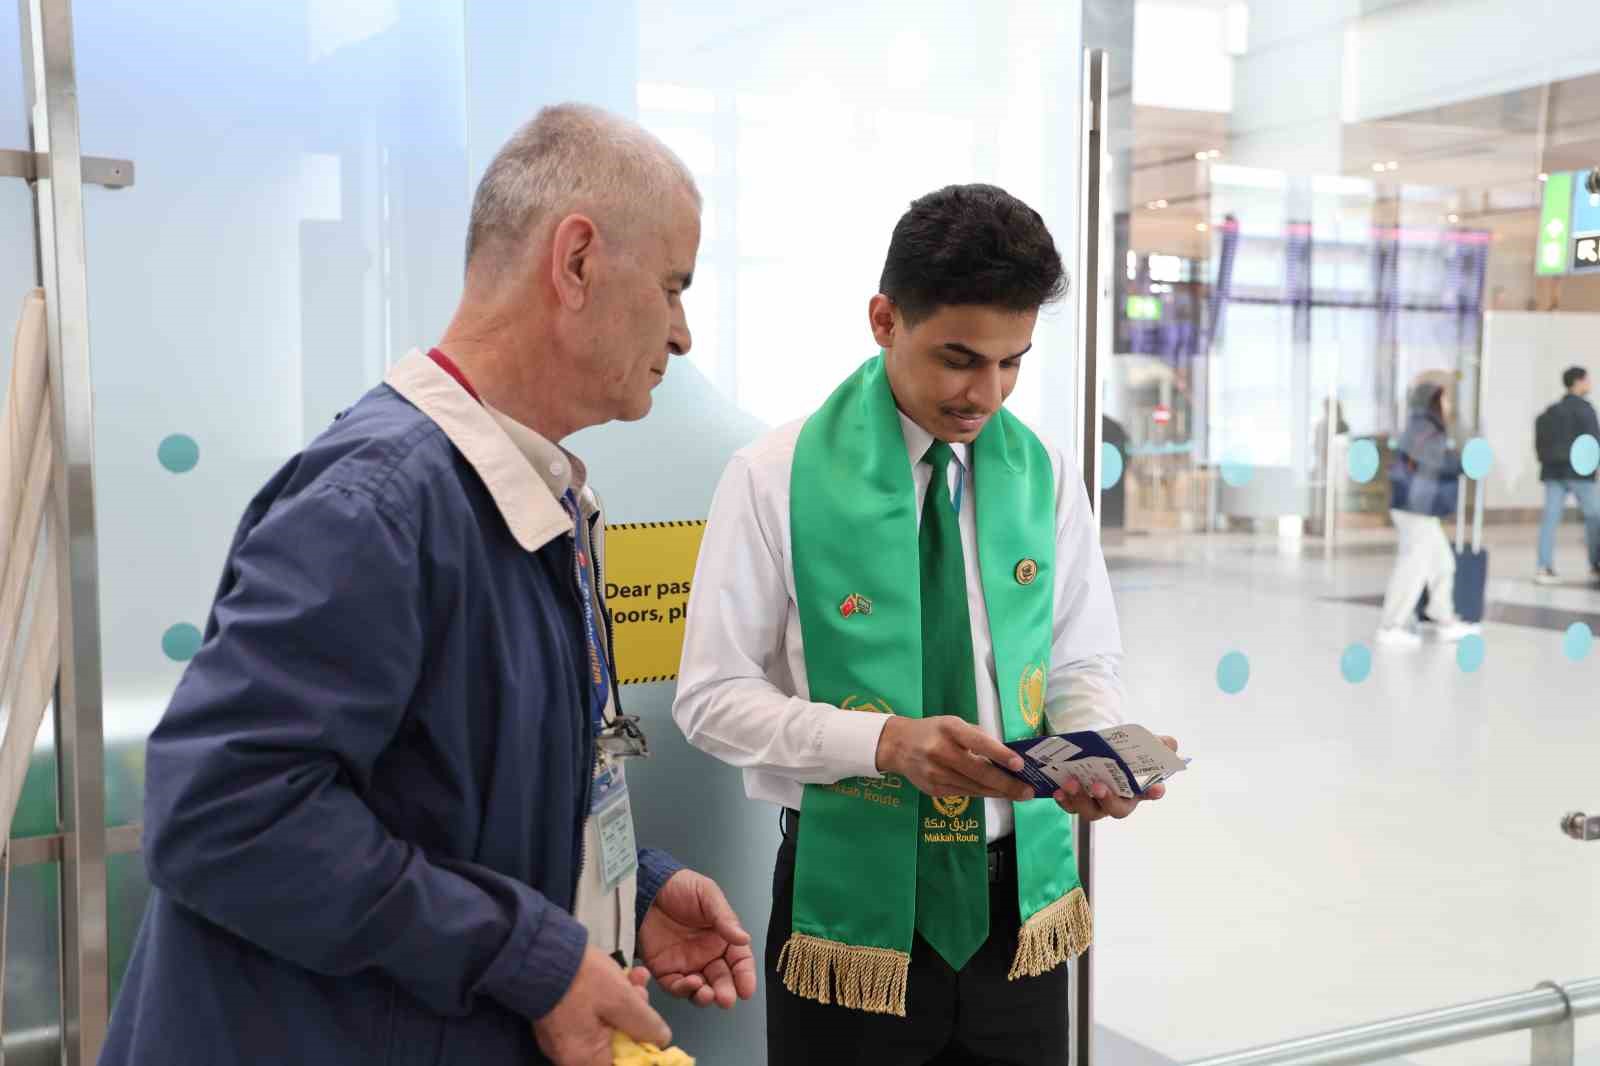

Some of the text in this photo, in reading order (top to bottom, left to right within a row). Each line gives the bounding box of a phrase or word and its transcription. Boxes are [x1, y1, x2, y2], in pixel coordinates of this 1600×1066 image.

[604, 581, 690, 600] Dear pas
[863, 787, 902, 809] Route
[924, 816, 979, 832] طريق مكة
[924, 832, 979, 843] Makkah Route
